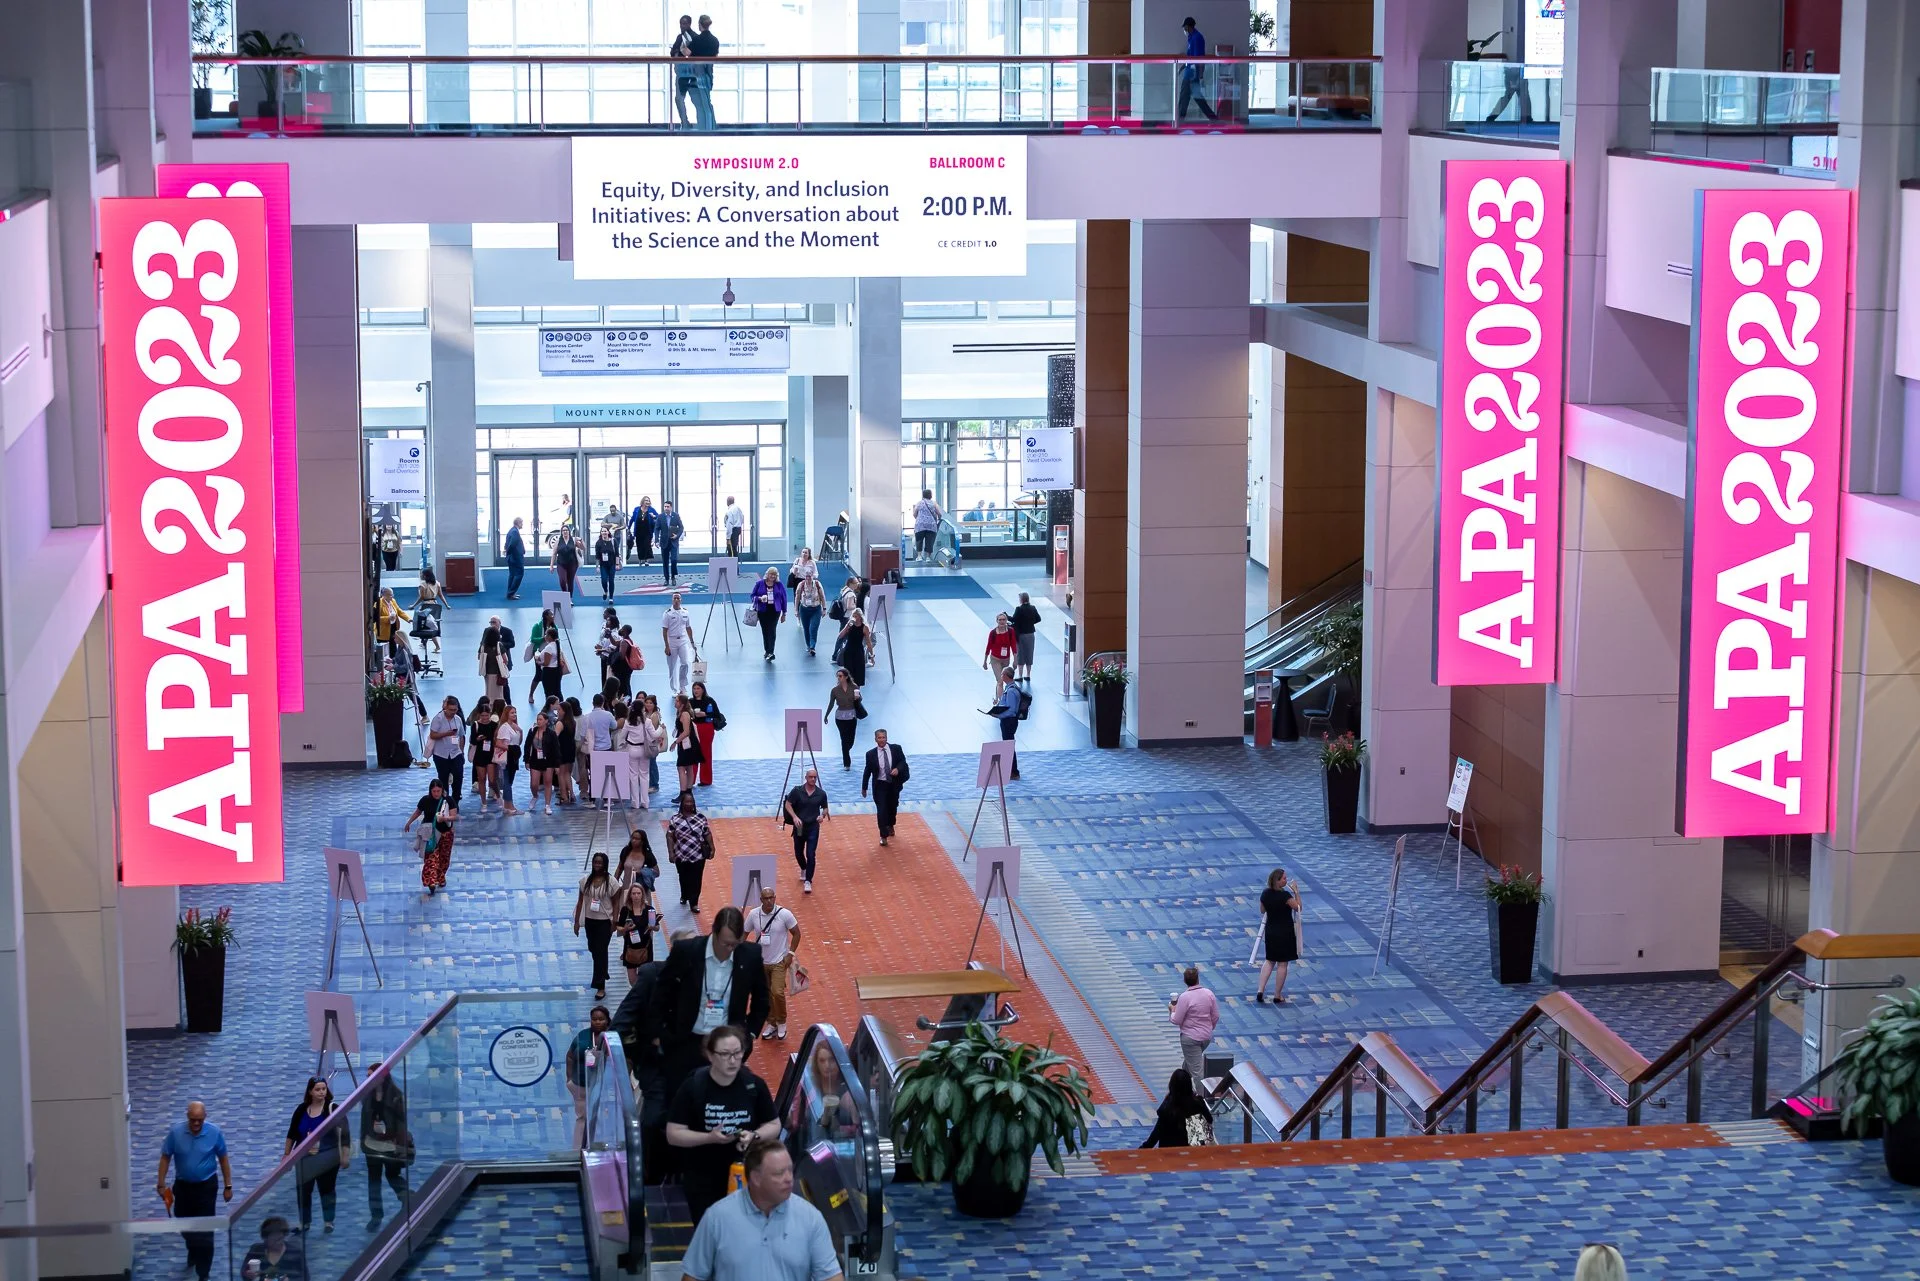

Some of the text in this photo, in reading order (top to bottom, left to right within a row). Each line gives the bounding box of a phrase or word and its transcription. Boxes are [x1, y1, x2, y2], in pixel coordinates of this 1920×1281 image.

[693, 157, 799, 170] SYMPOSIUM 2.0
[929, 156, 1006, 169] BALLROOM C
[602, 179, 889, 202] Equity, Diversity, and Inclusion
[922, 196, 1012, 216] 2:00 P.M.
[592, 205, 900, 224] Initiatives: A Conversation about
[611, 230, 880, 249] the Science and the Moment
[937, 240, 997, 248] CE CREDIT 1.0
[565, 408, 687, 417] MOUNT VERNON PLACE
